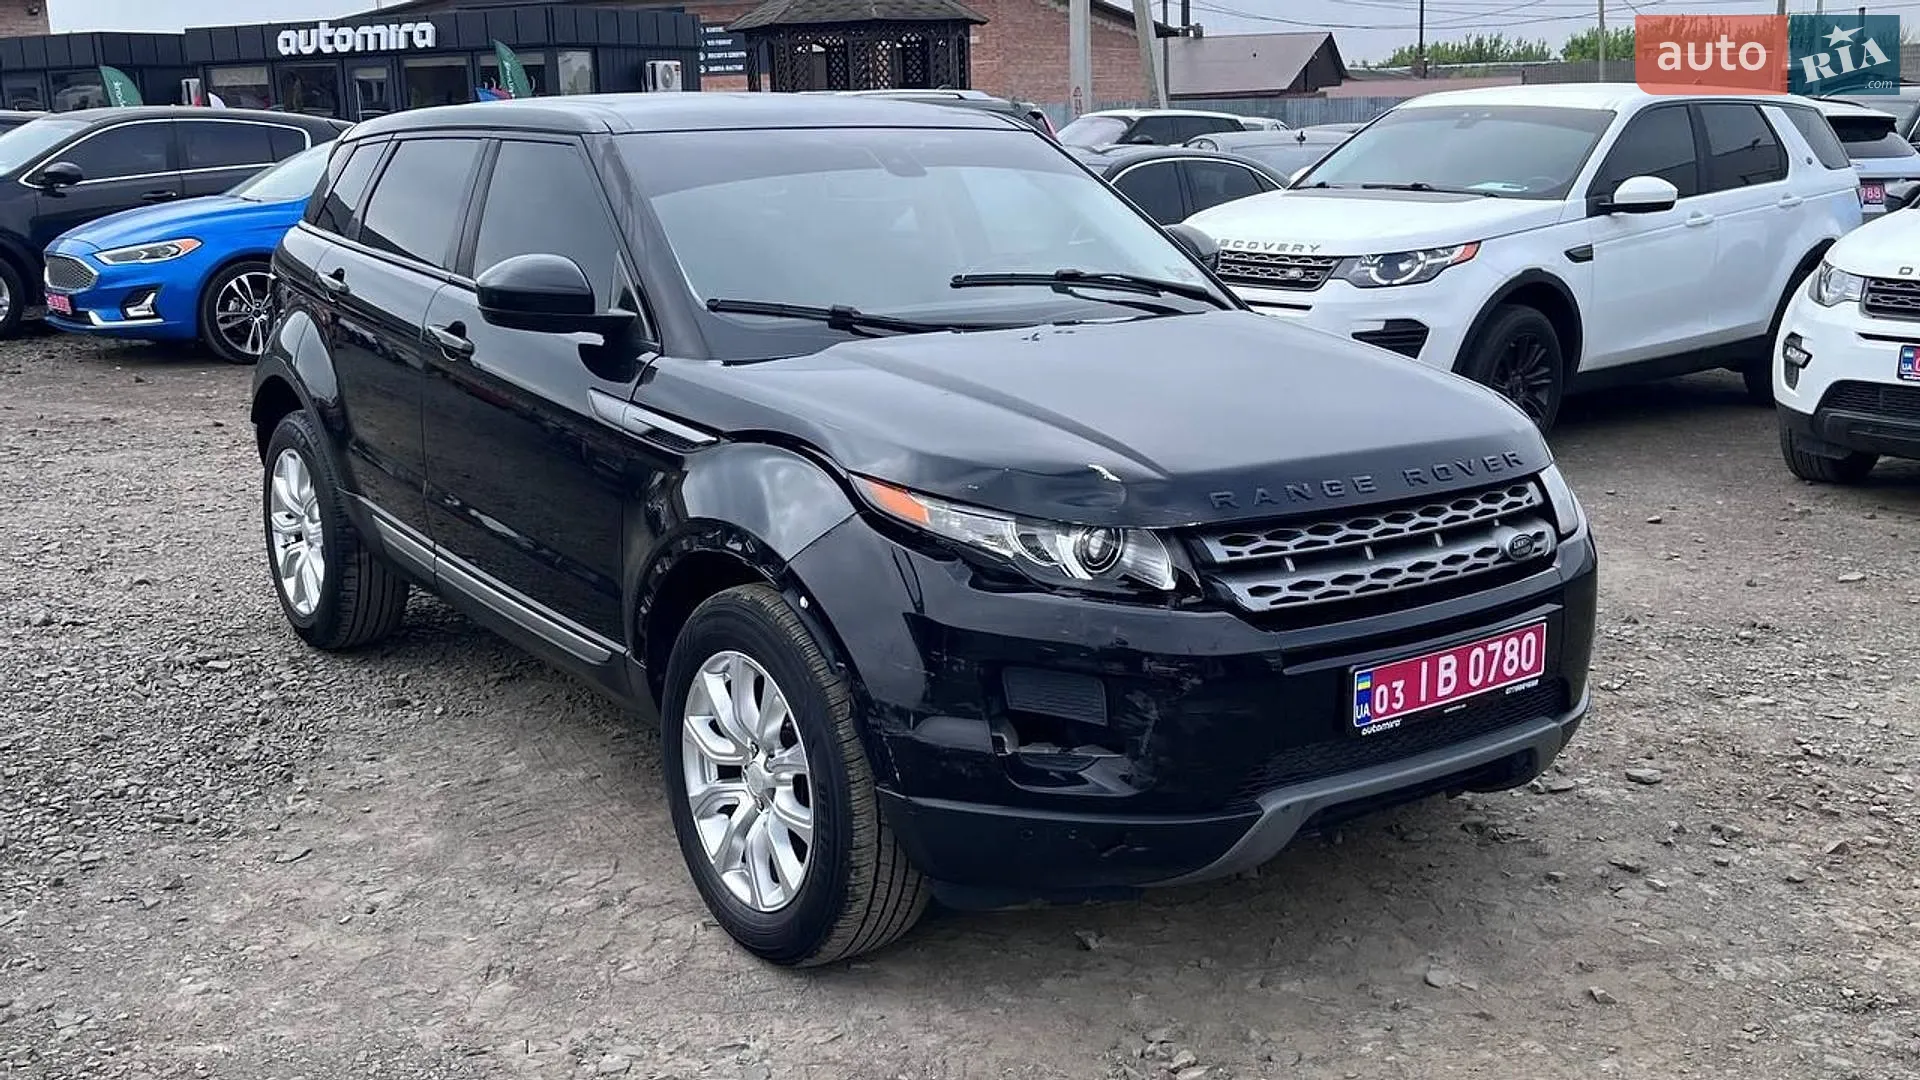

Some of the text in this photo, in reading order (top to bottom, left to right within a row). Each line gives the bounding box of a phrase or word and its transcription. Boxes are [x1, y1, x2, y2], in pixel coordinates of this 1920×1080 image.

[277, 22, 436, 55] automira
[1209, 450, 1525, 510] RANGE ROVER
[1375, 679, 1405, 714] 03
[1468, 631, 1537, 687] 0780
[1355, 703, 1371, 720] UA
